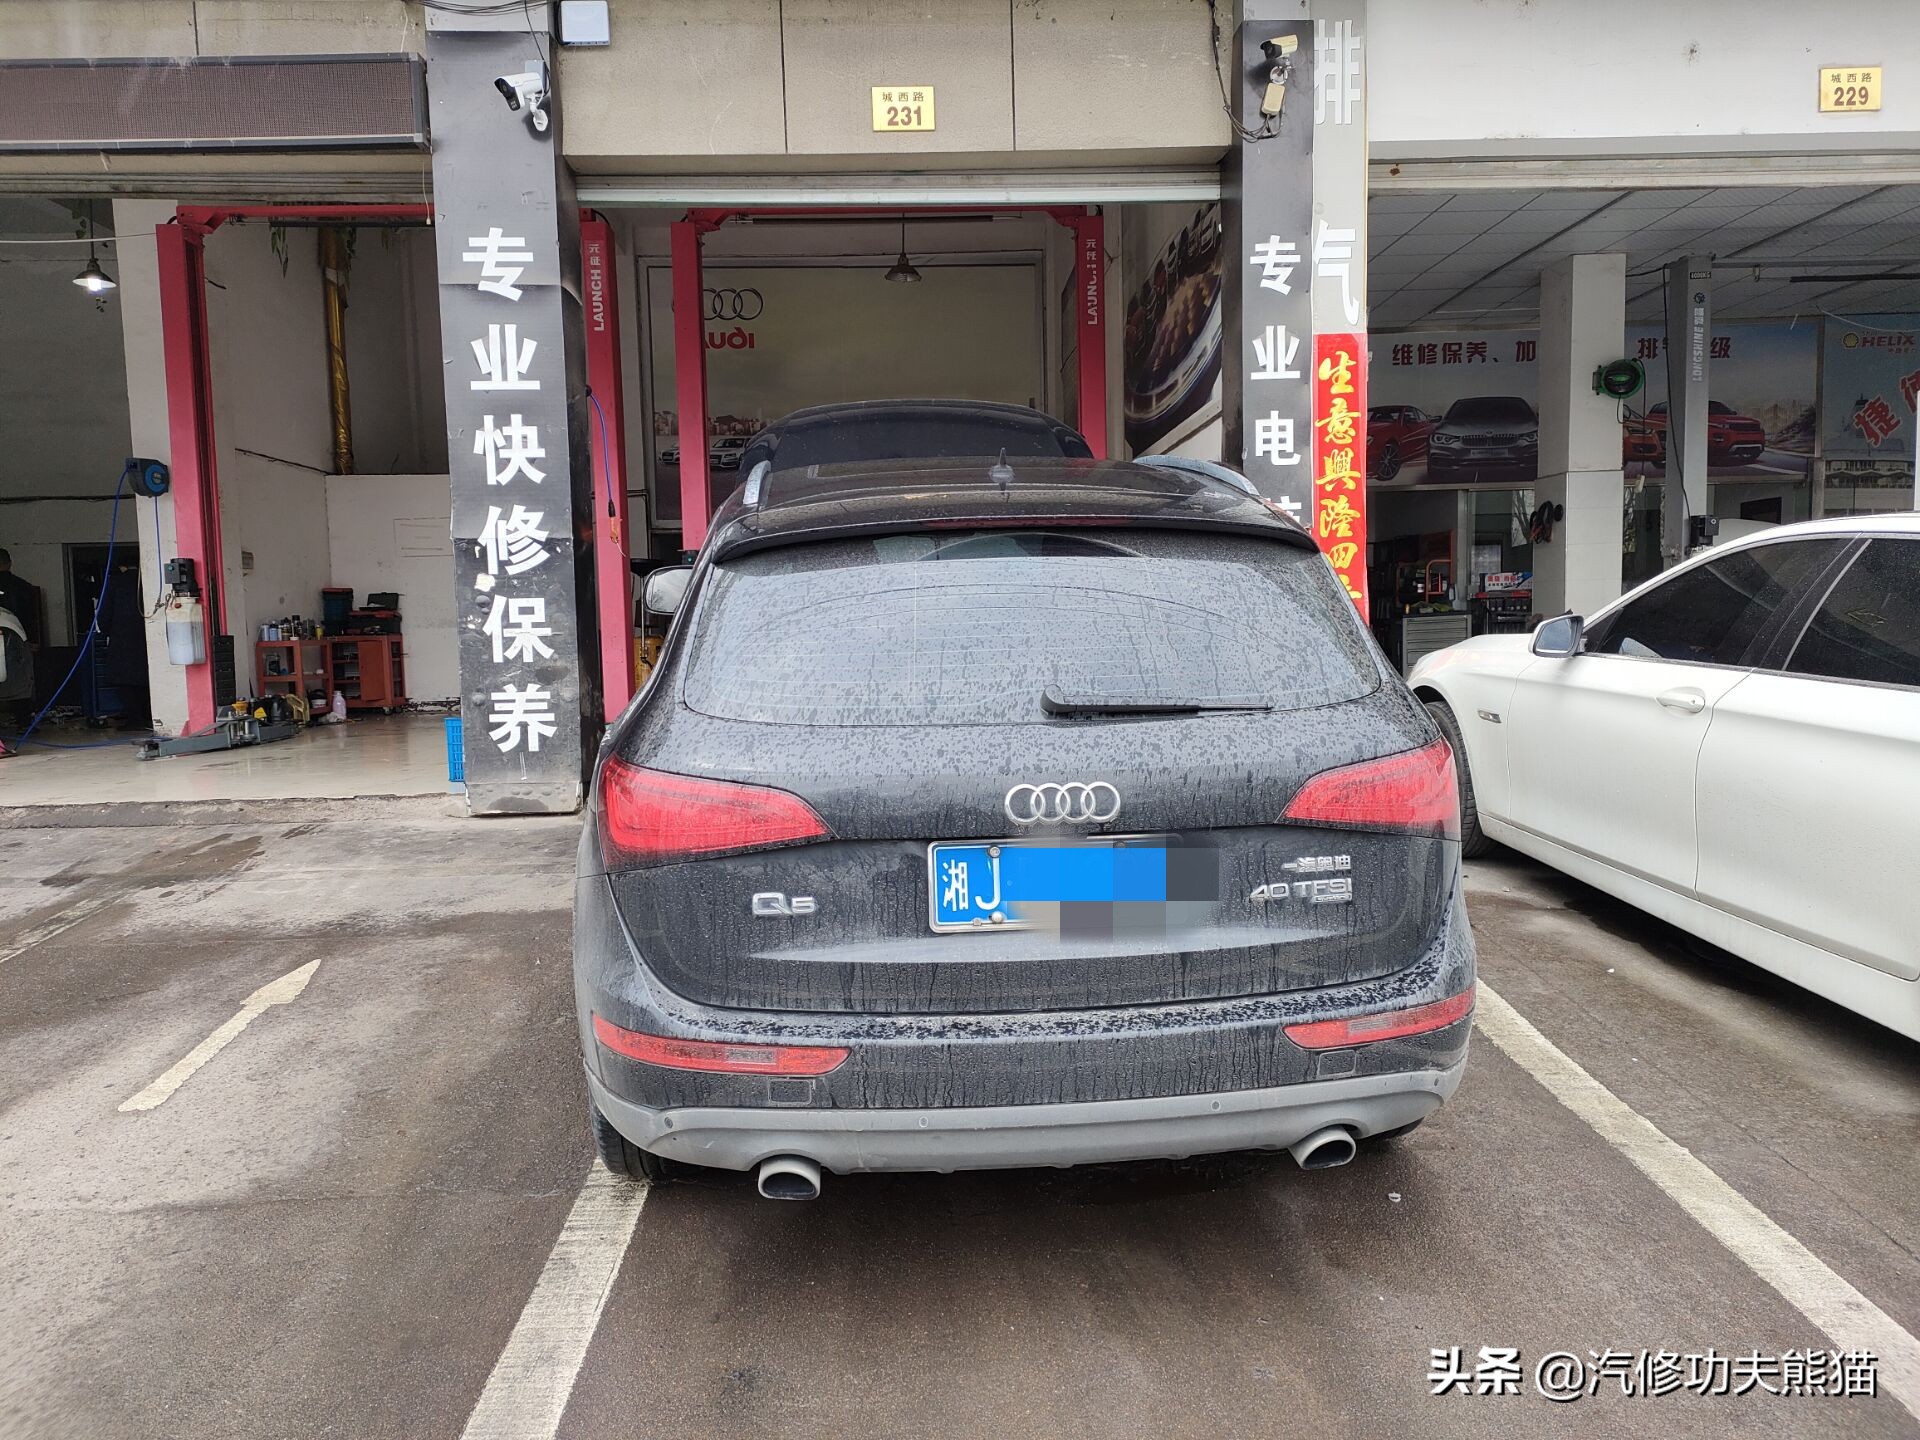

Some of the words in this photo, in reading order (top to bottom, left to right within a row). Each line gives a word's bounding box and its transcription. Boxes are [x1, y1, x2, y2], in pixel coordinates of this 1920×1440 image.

[1831, 72, 1872, 83] 城西路
[882, 91, 924, 102] 城西路
[1834, 86, 1869, 106] 229
[887, 105, 921, 126] 231
[591, 269, 605, 331] LAUNCH
[1861, 335, 1914, 347] HELIX
[1392, 340, 1536, 366] 维修保养、加
[1692, 326, 1703, 382] LONGSHINE
[462, 227, 558, 753] 专业快修保养
[1250, 883, 1289, 900] 40
[1293, 878, 1352, 898] TFSI
[752, 892, 815, 915] Q5
